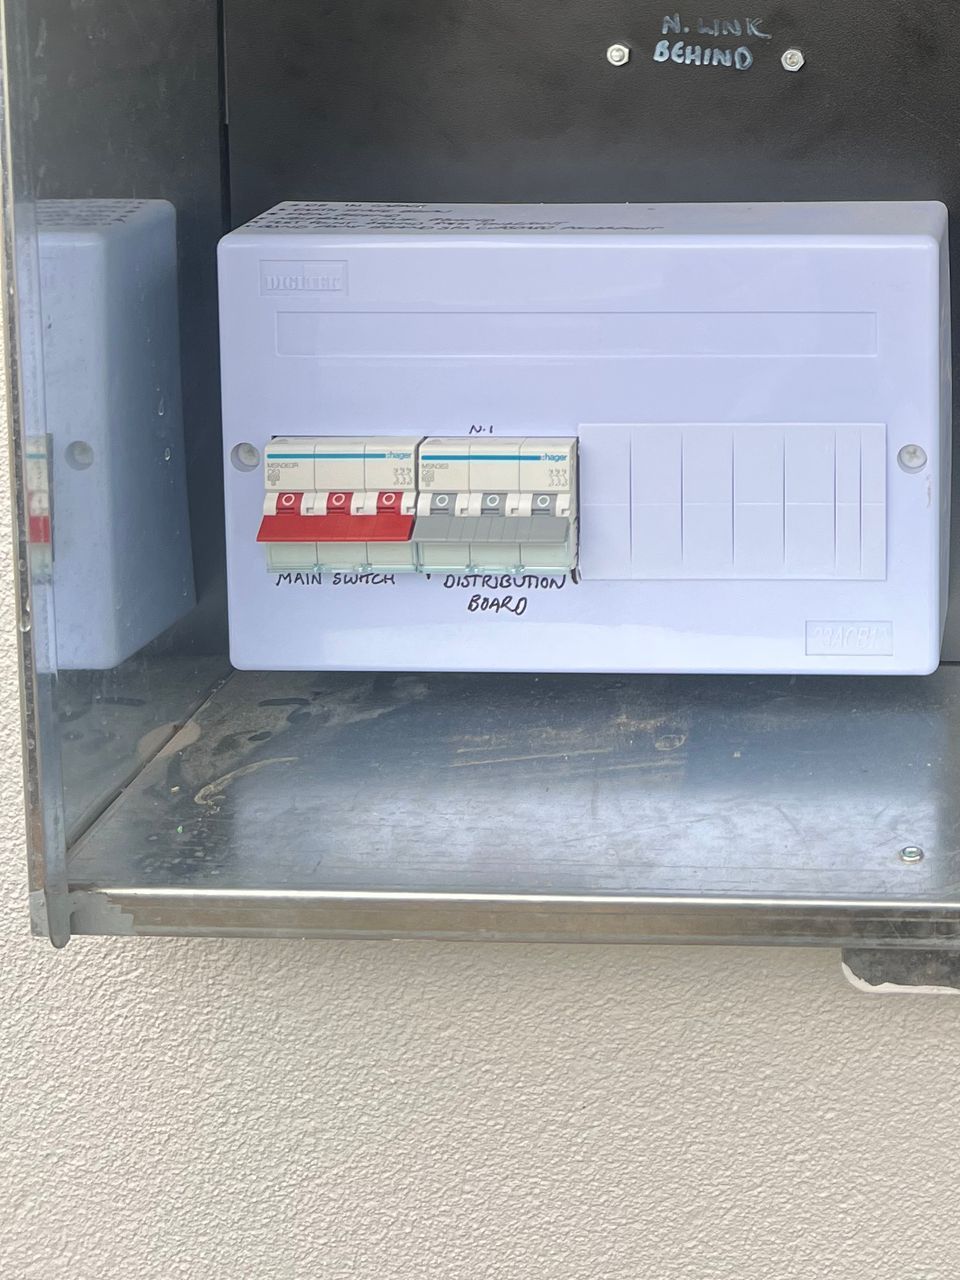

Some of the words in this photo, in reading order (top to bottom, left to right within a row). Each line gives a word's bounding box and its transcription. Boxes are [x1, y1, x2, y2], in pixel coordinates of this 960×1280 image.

[698, 17, 773, 40] LINK
[652, 39, 754, 70] BEHIND
[276, 572, 322, 587] MAIN
[332, 572, 396, 586] SWITCH
[443, 573, 567, 590] DISTRIBUTION
[467, 594, 528, 616] BOARD
